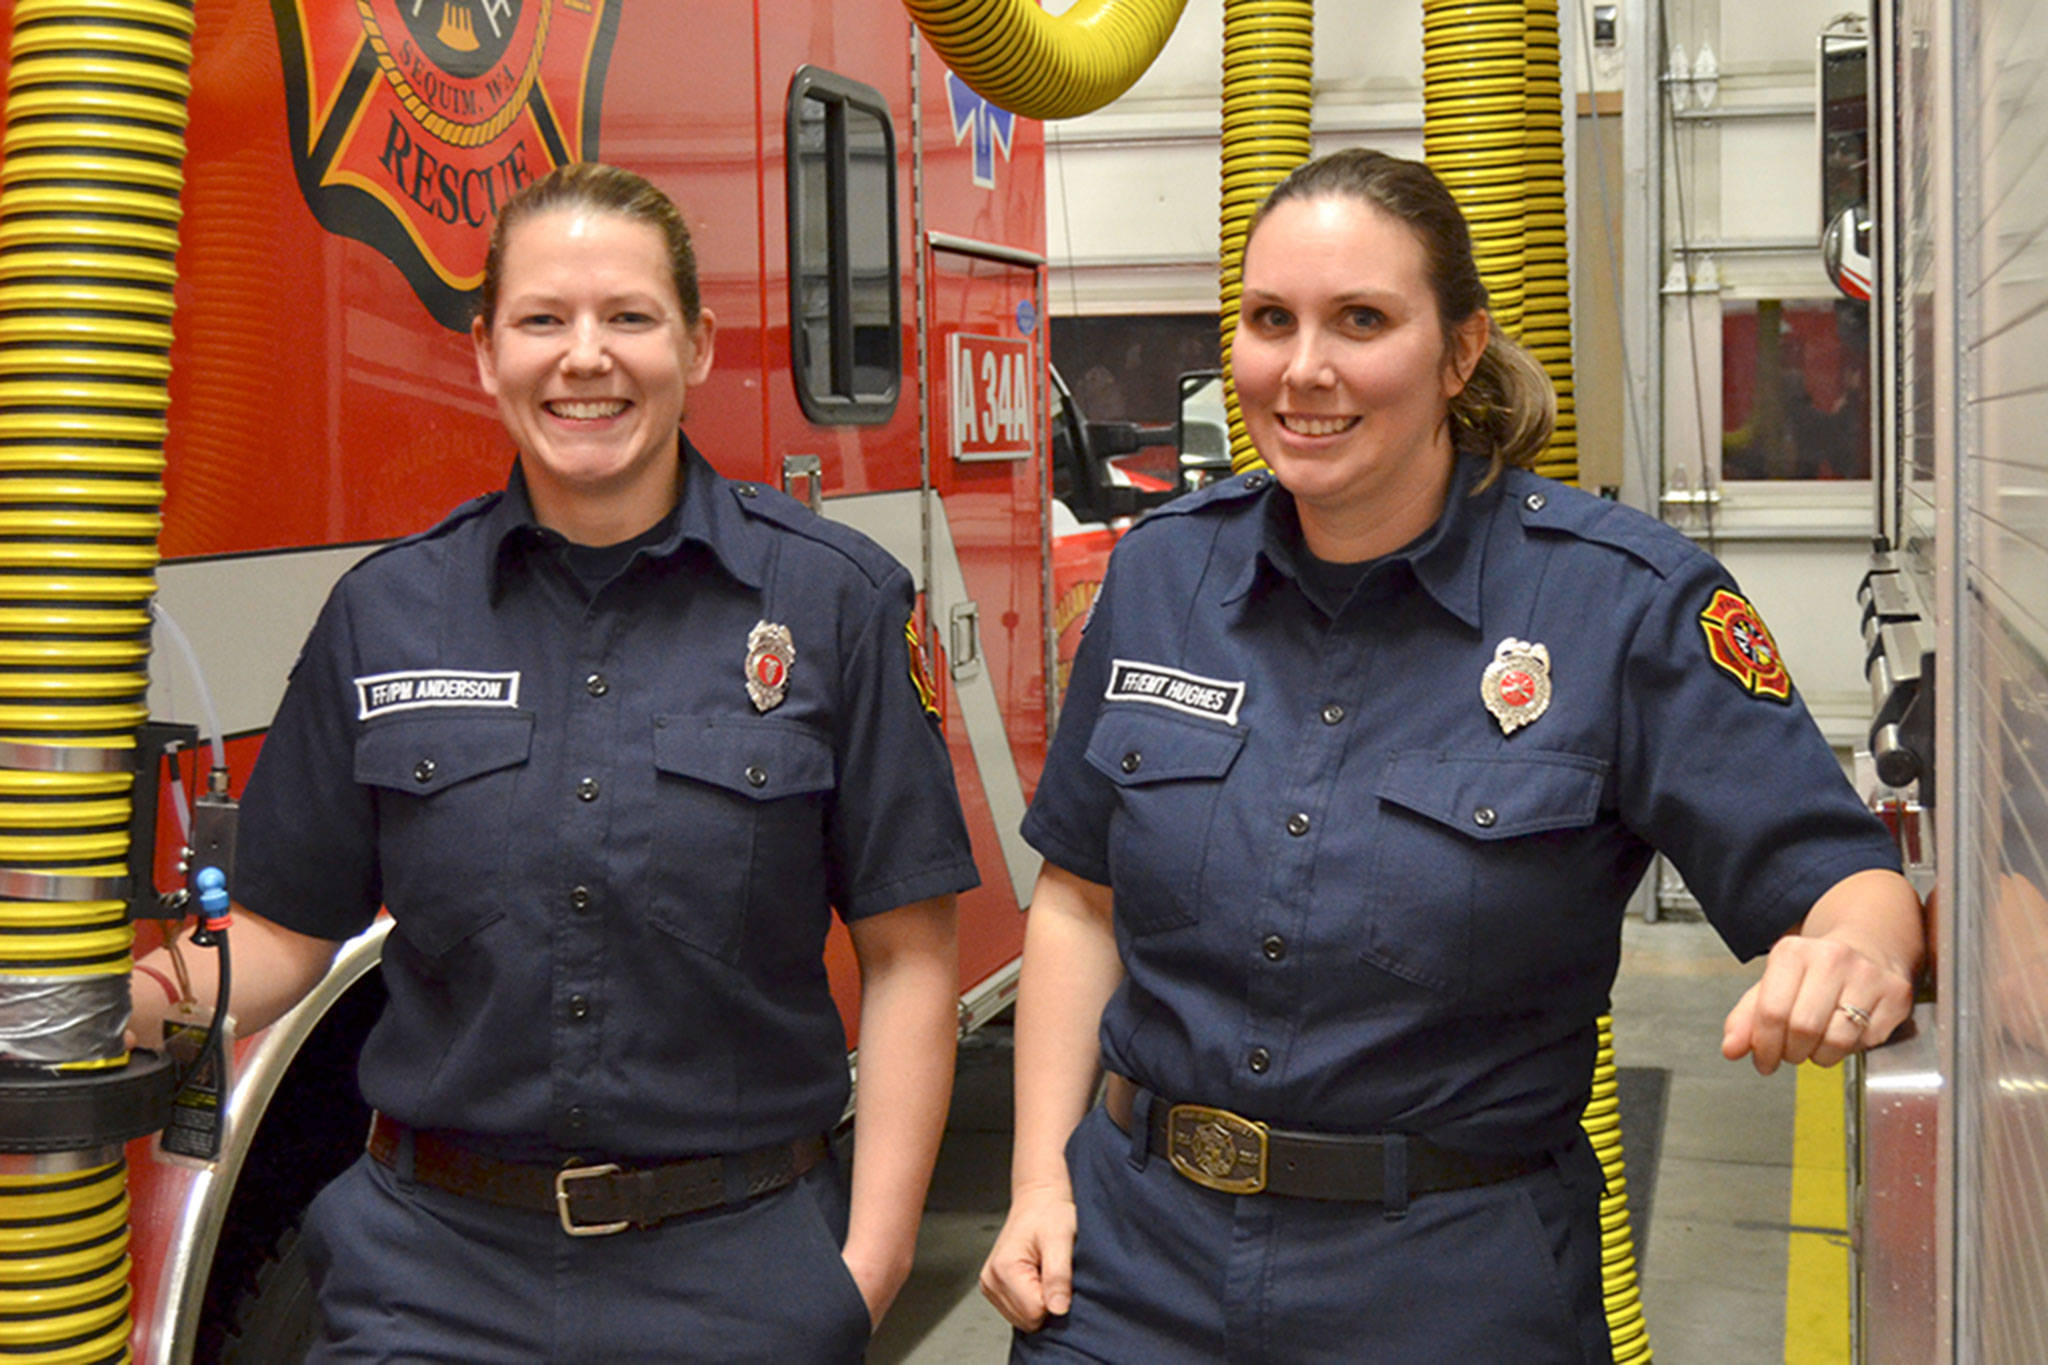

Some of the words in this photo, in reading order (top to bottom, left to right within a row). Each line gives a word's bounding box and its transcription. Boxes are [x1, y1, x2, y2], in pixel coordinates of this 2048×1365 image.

[485, 63, 515, 104] WA
[377, 109, 535, 229] RESCUE
[959, 348, 979, 444] A
[981, 349, 1031, 445] 34A
[415, 679, 502, 699] ANDERSON
[1164, 679, 1228, 711] HUGHES
